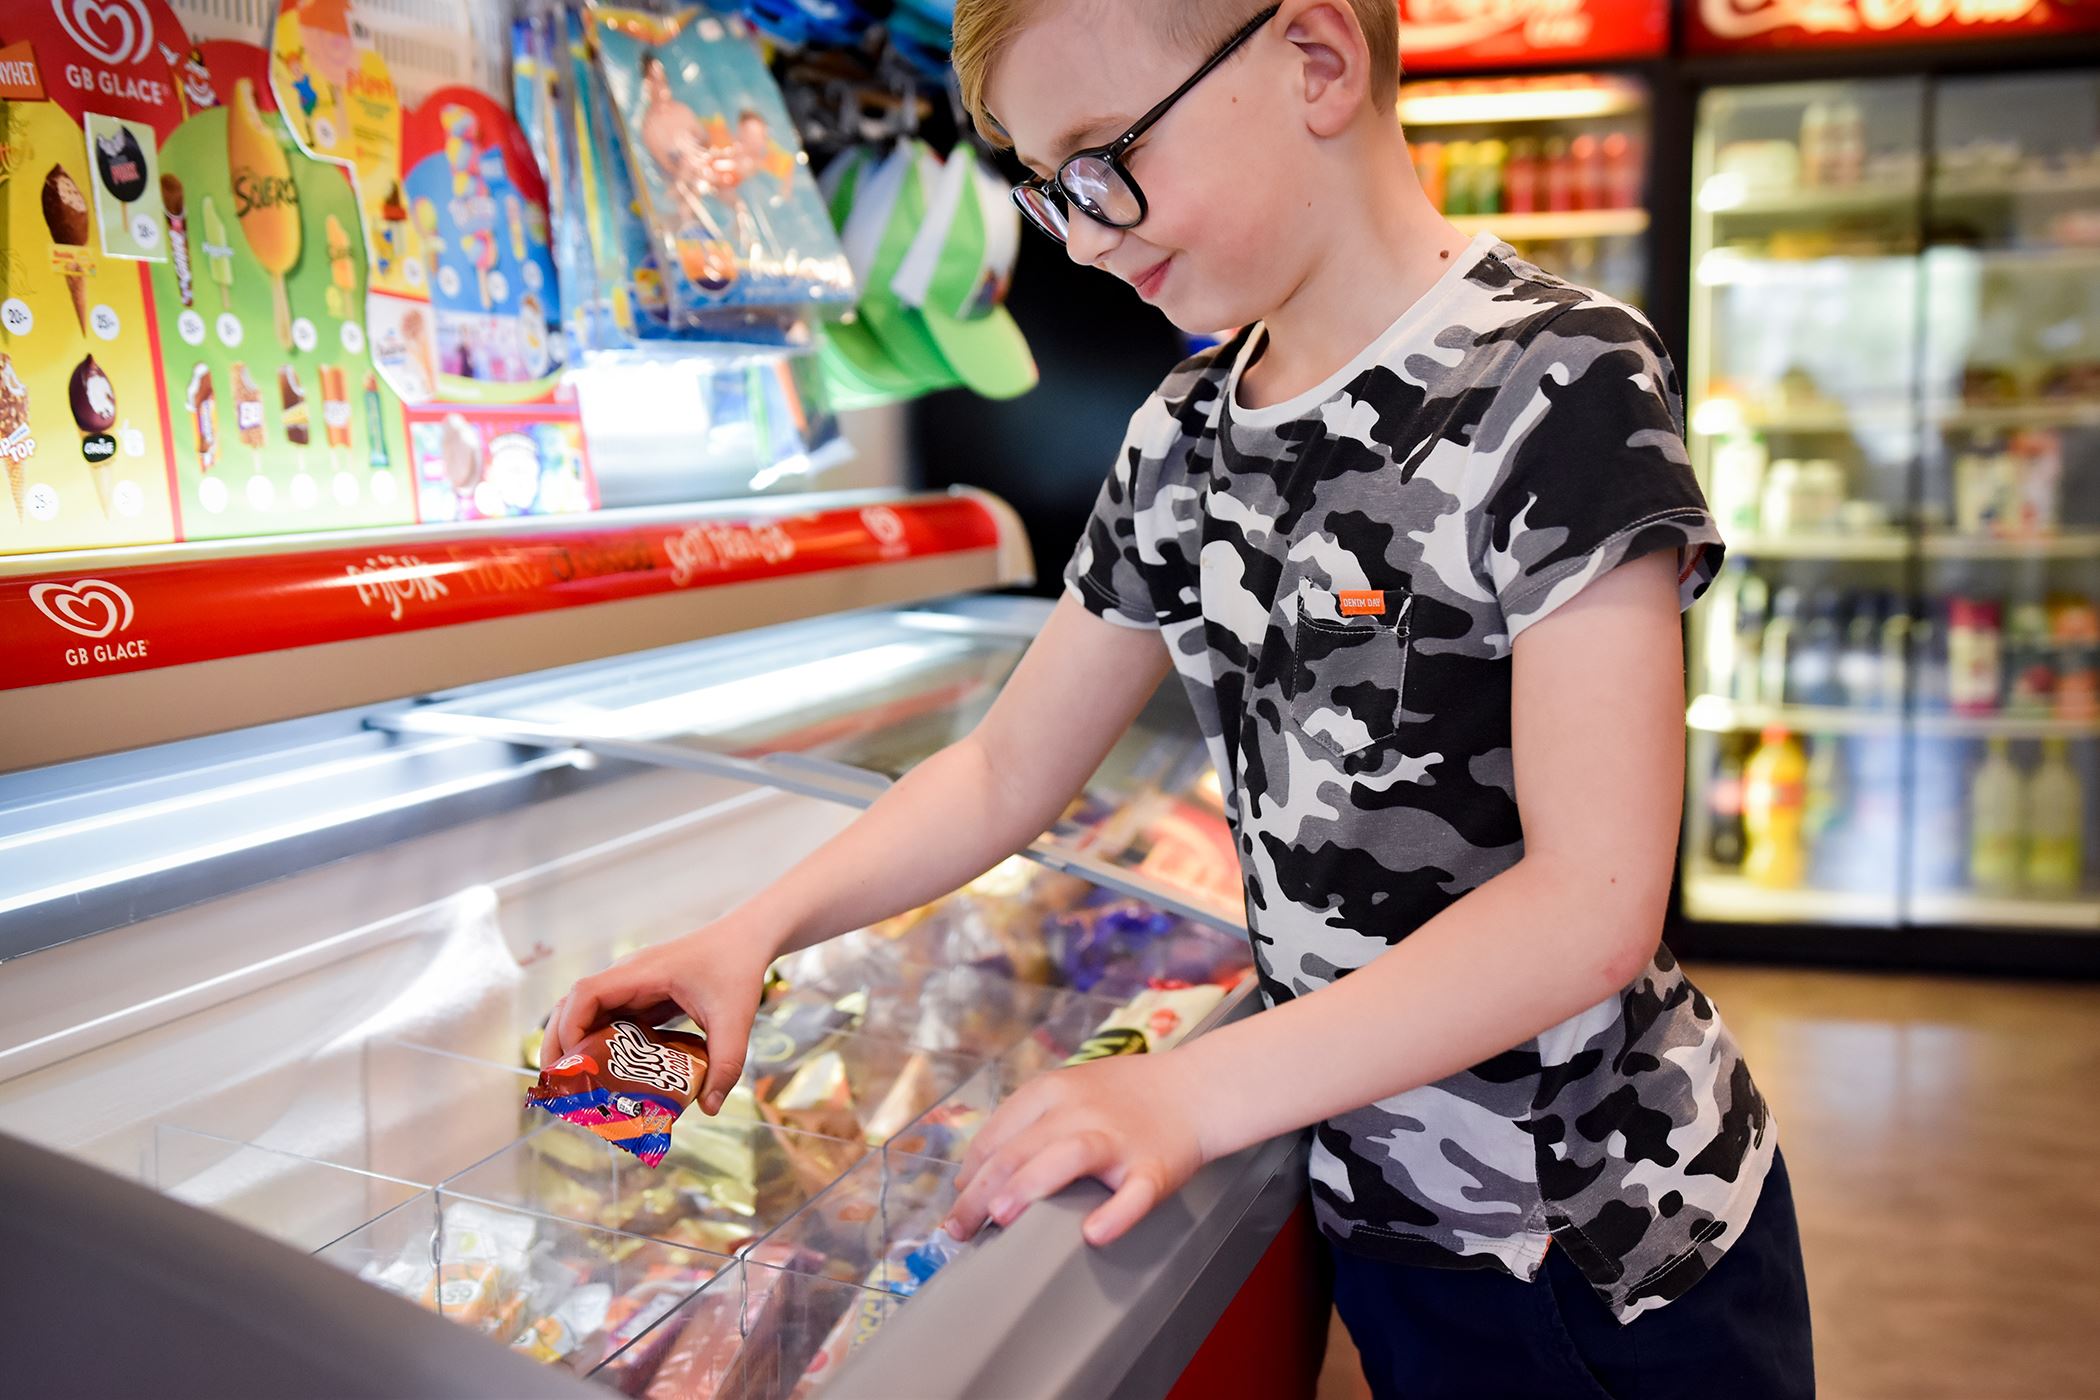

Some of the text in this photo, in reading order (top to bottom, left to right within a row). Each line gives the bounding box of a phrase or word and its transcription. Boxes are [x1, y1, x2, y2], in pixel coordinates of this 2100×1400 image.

[65, 63, 164, 107] GB GLACE
[9, 437, 36, 464] TOP
[1343, 597, 1381, 608] DENIM DAY
[65, 639, 148, 667] GB GLACE
